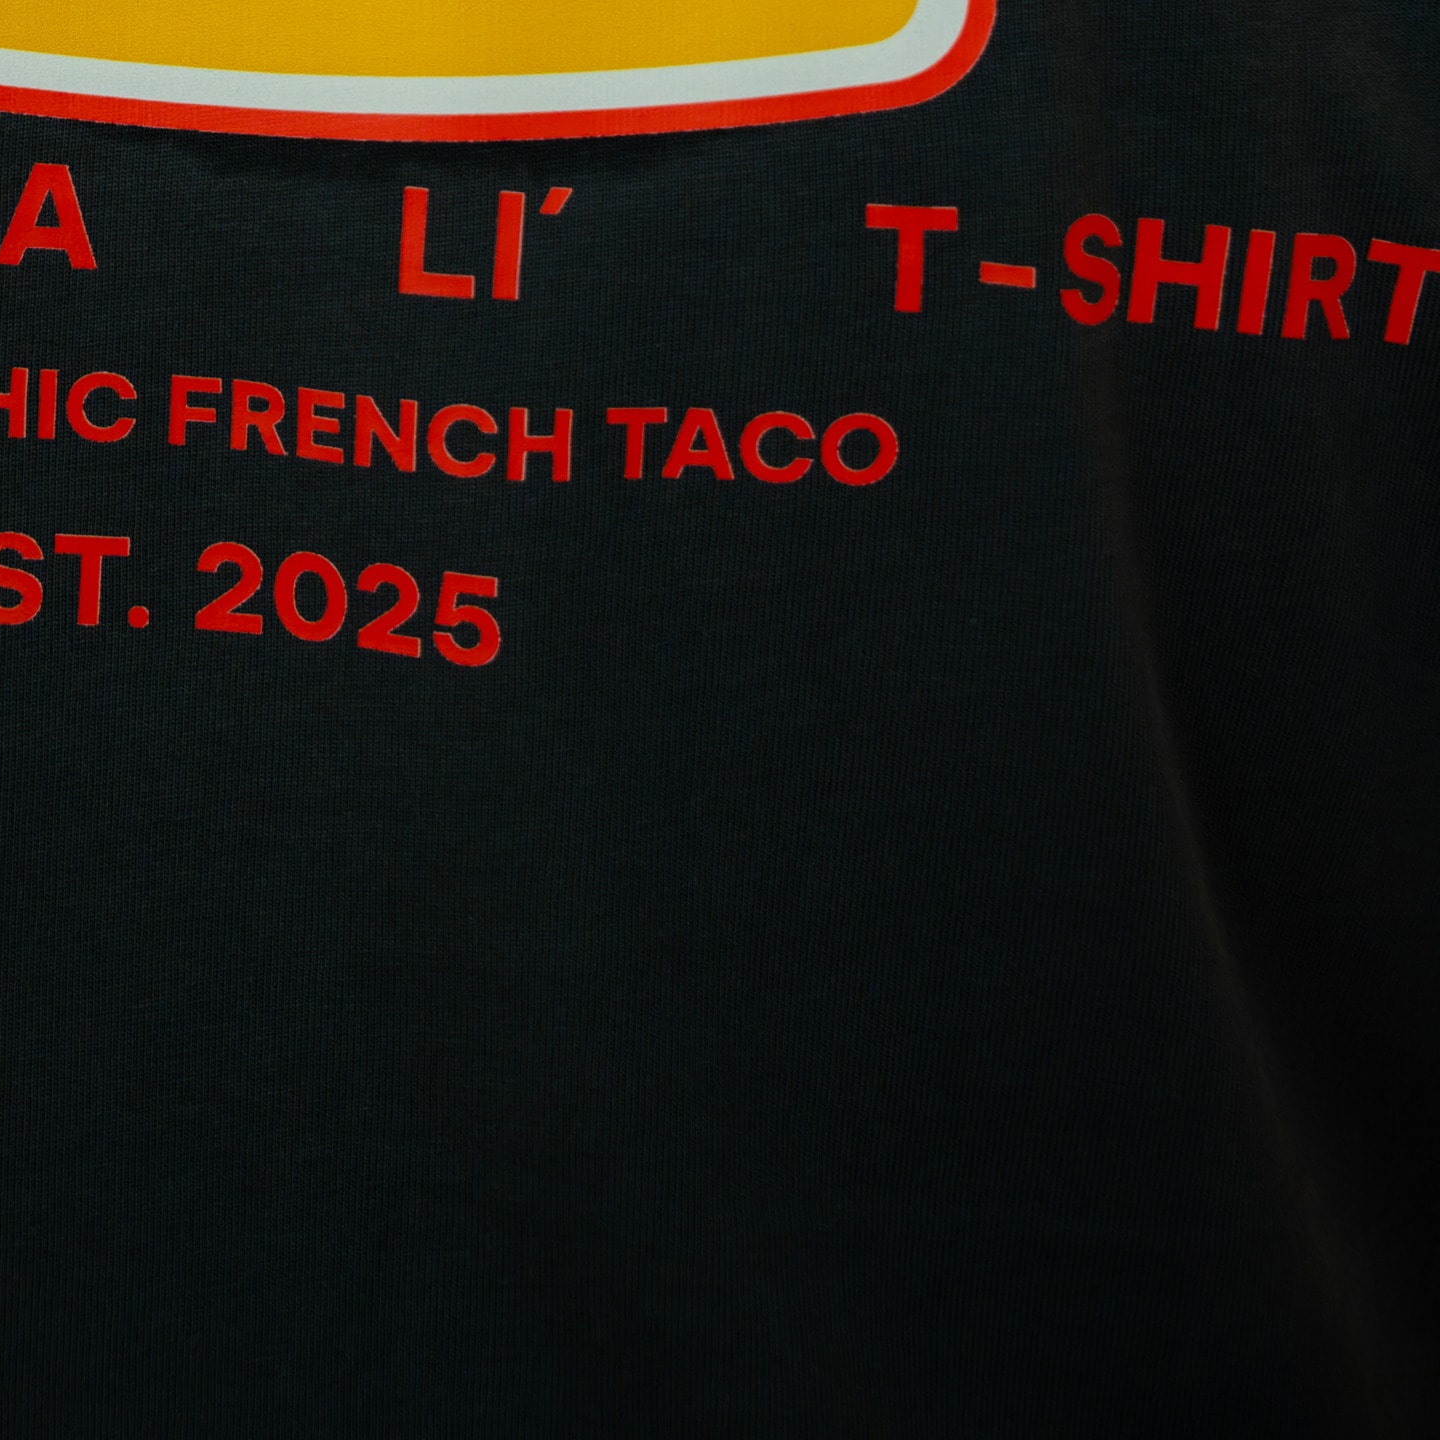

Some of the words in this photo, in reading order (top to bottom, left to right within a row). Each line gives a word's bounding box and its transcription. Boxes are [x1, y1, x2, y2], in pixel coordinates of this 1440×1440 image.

[168, 374, 574, 482] FRENCH
[606, 406, 900, 487] TACO
[195, 541, 502, 668] 2025
